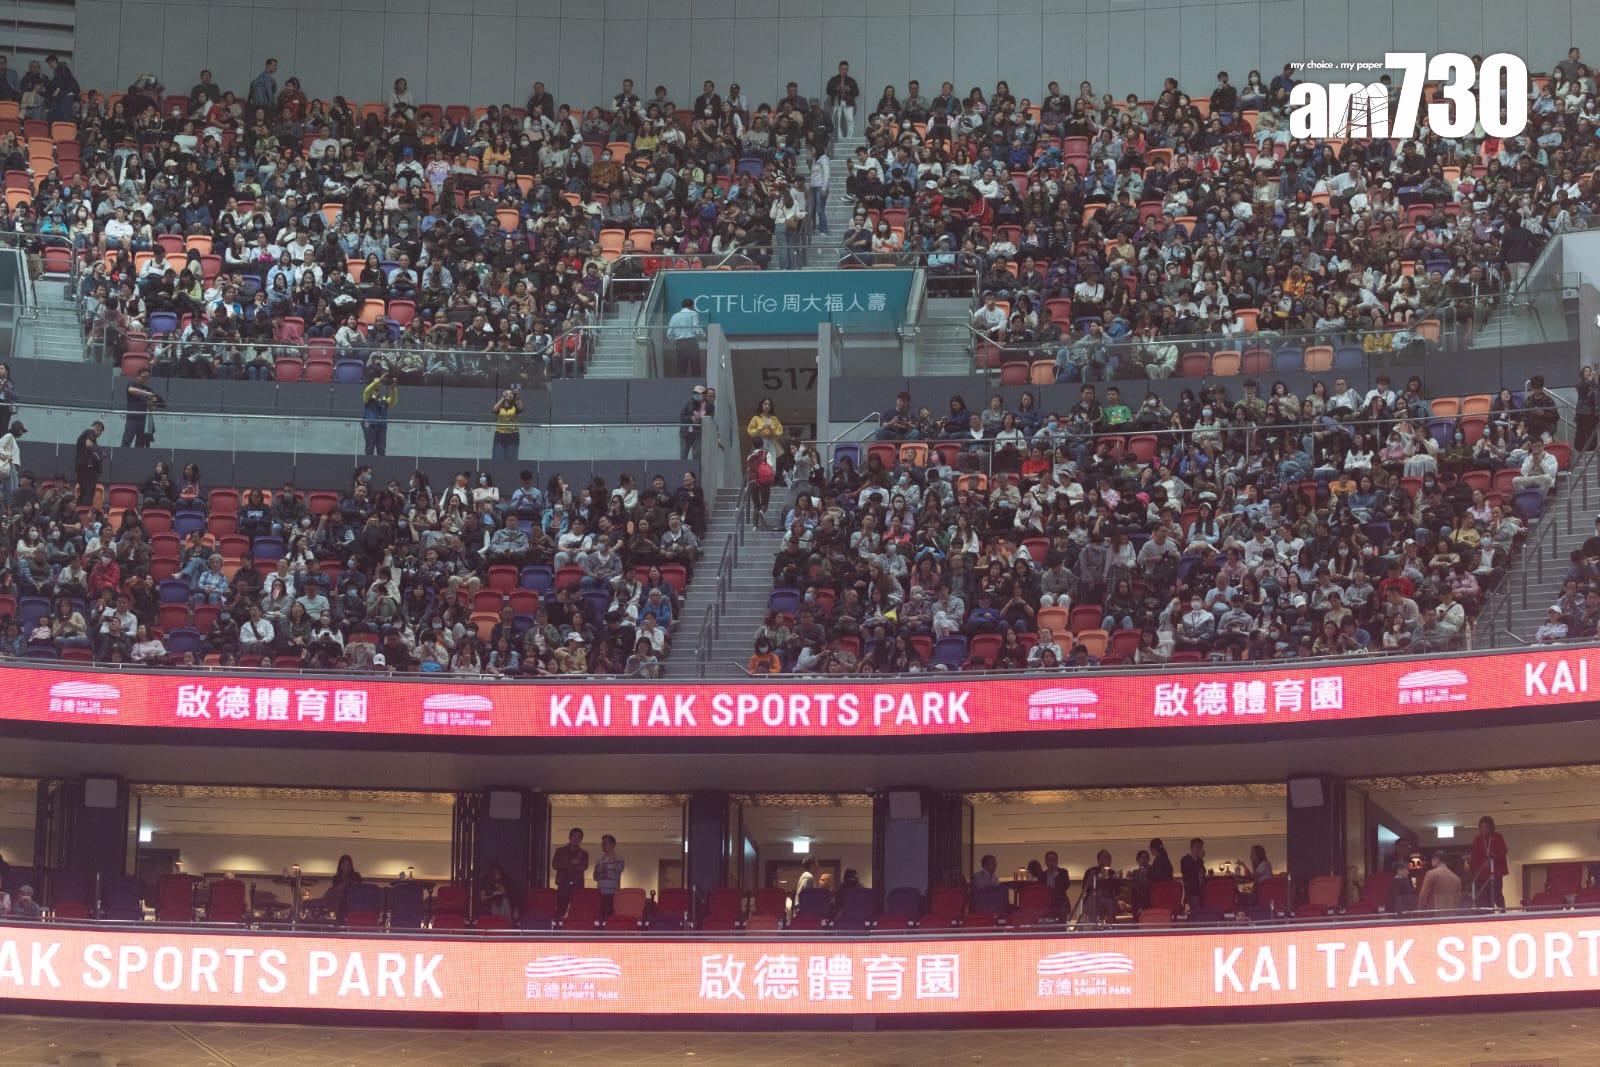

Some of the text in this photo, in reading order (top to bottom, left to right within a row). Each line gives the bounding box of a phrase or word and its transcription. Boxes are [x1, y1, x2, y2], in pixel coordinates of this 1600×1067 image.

[693, 293, 887, 313] CTFLife 周大福人壽
[761, 367, 818, 391] 517
[1153, 676, 1344, 717] 啟德體育園
[1525, 658, 1588, 697] KAI
[176, 684, 369, 723] 啟德體育園
[549, 691, 971, 727] KAI TAK SPORTS PARK
[82, 943, 288, 994] SPORTS
[308, 949, 444, 998] PARK
[697, 953, 961, 1001] 啟德體育園
[1213, 930, 1600, 993] KAI TAK SPORT
